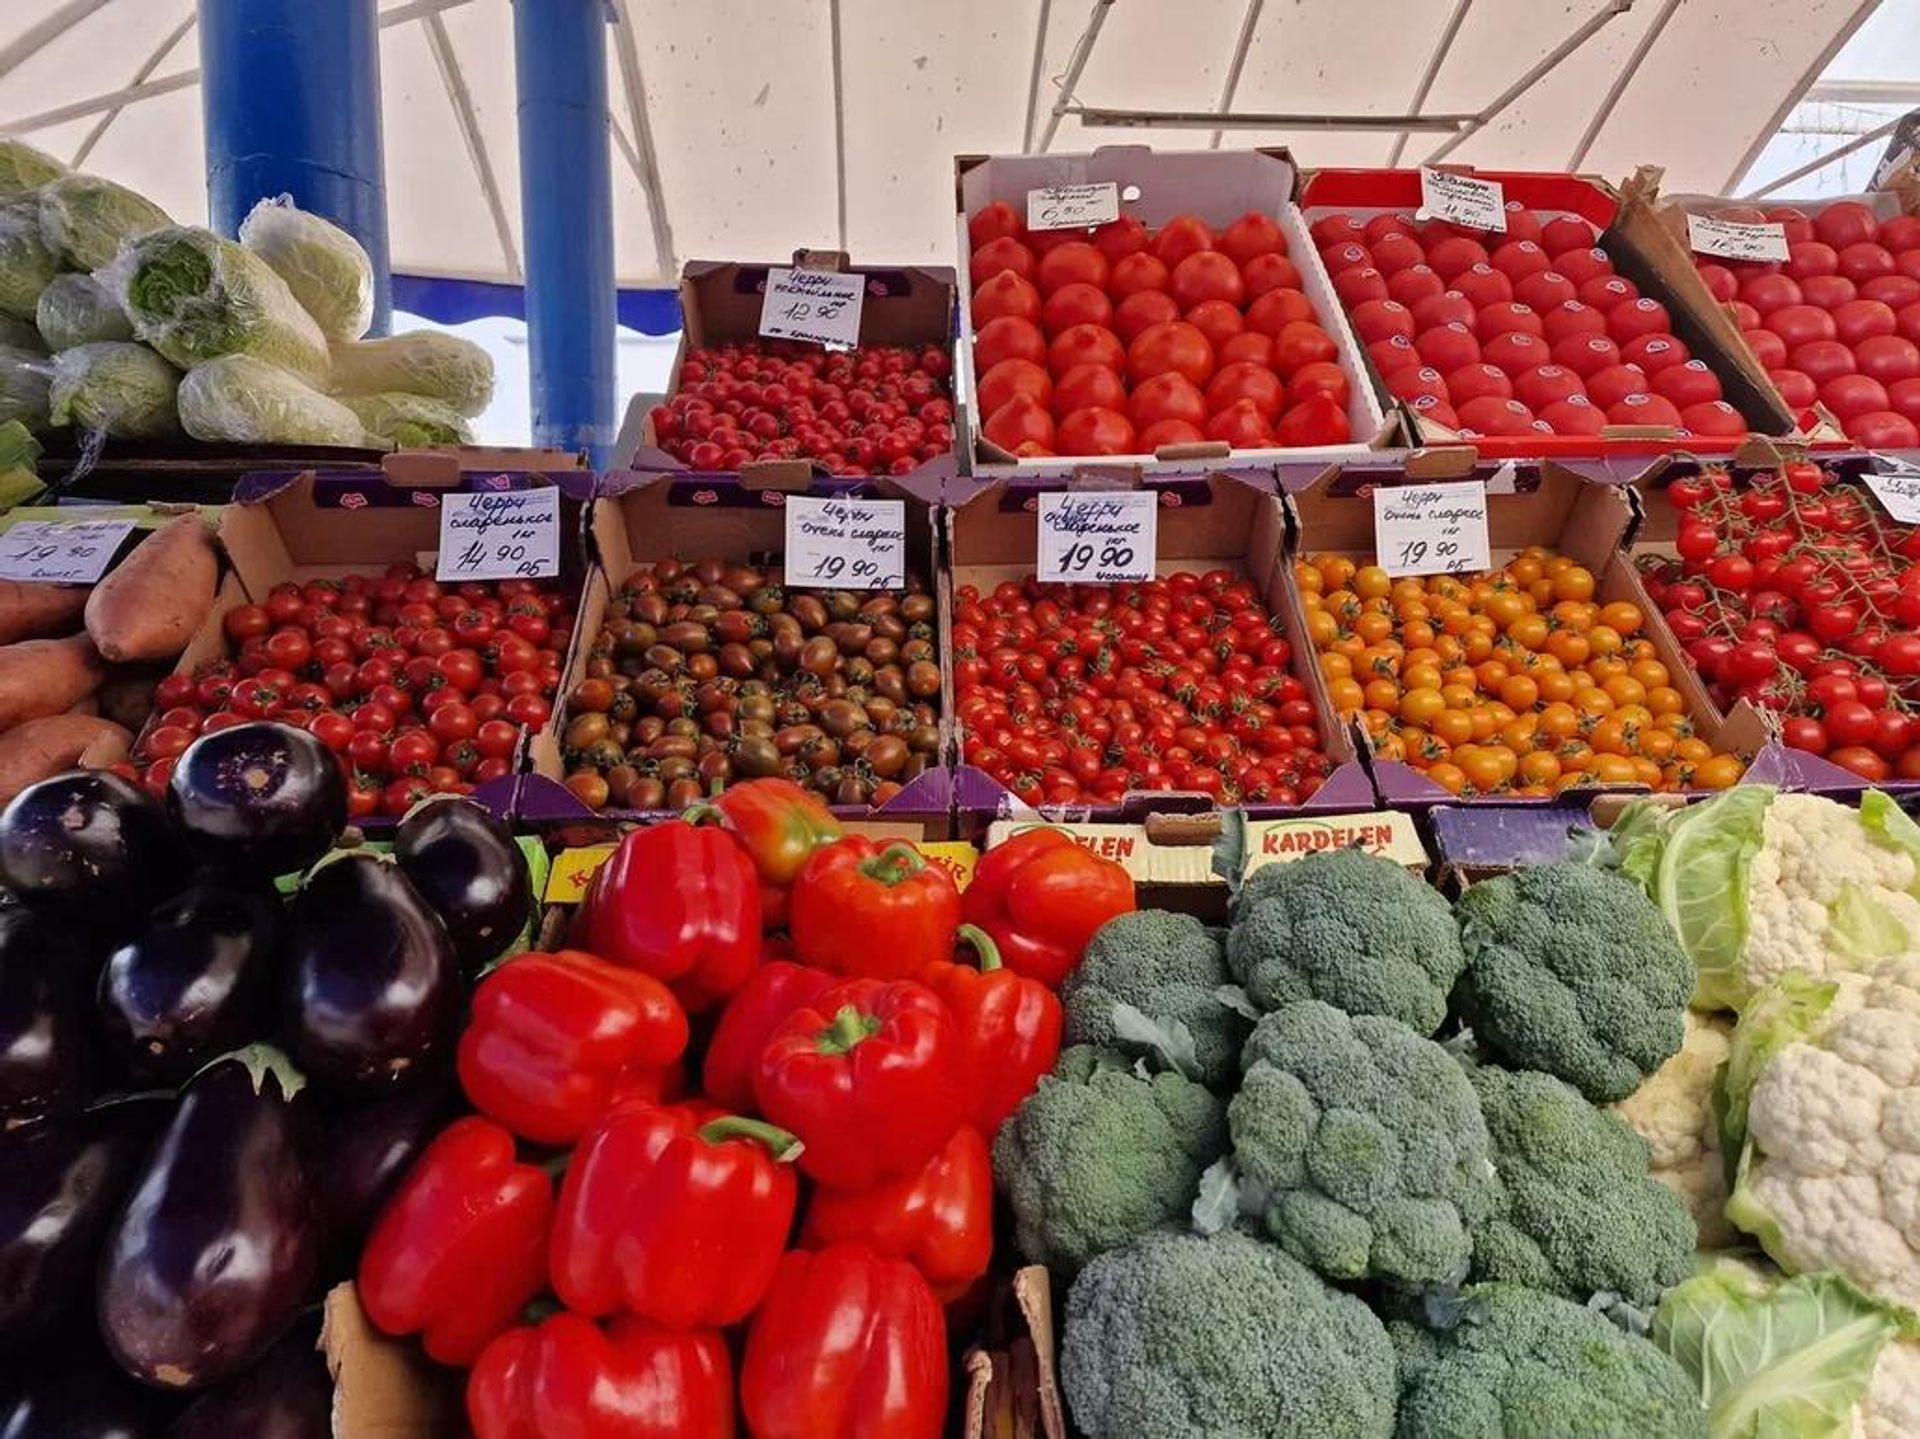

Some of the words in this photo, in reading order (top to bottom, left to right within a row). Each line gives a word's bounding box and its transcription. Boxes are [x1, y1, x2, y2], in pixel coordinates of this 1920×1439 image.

[784, 301, 810, 321] 12
[469, 494, 527, 515] Черри
[1060, 495, 1125, 520] Черри
[1402, 491, 1443, 507] Черри
[456, 540, 488, 571] 14
[497, 545, 525, 561] 90
[1058, 542, 1094, 573] 19
[1098, 546, 1134, 567] 90
[1400, 541, 1428, 566] 19
[1435, 542, 1459, 556] 90
[813, 555, 846, 579] 19
[851, 558, 879, 577] 90
[1263, 824, 1392, 855] KARDELEN
